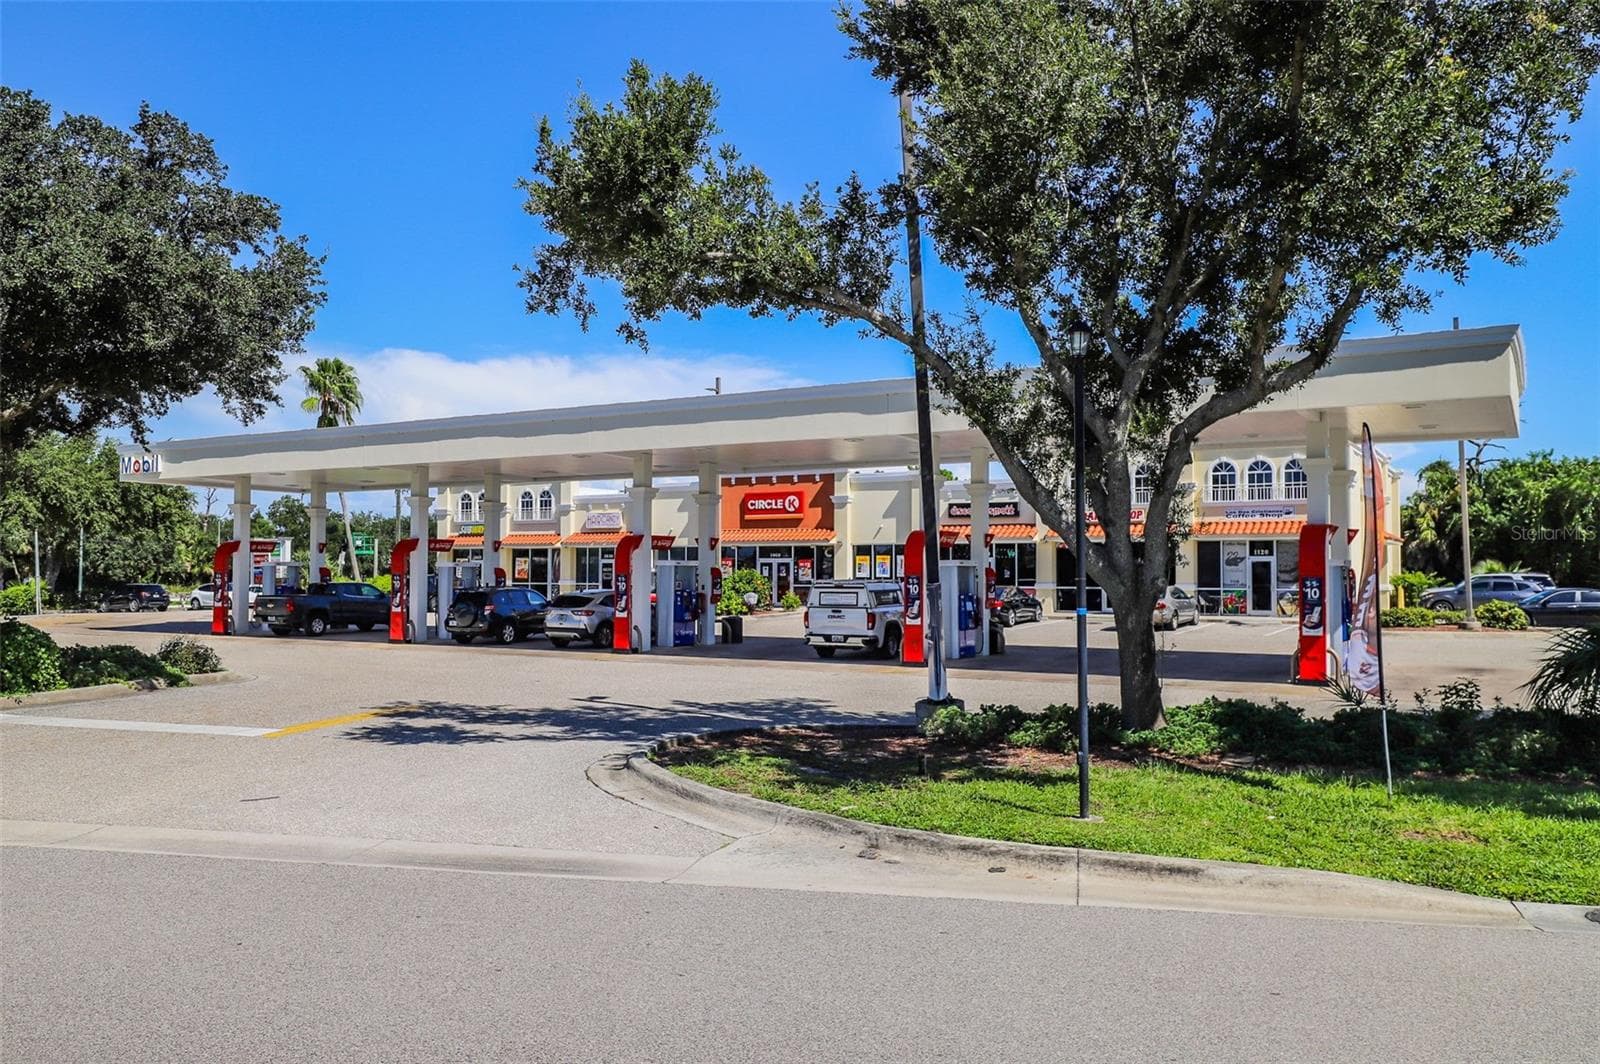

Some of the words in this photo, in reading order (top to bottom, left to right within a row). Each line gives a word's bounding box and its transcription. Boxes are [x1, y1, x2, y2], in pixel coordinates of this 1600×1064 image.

[121, 455, 159, 474] Mobil
[747, 499, 784, 510] CIRCLE
[785, 495, 799, 511] K
